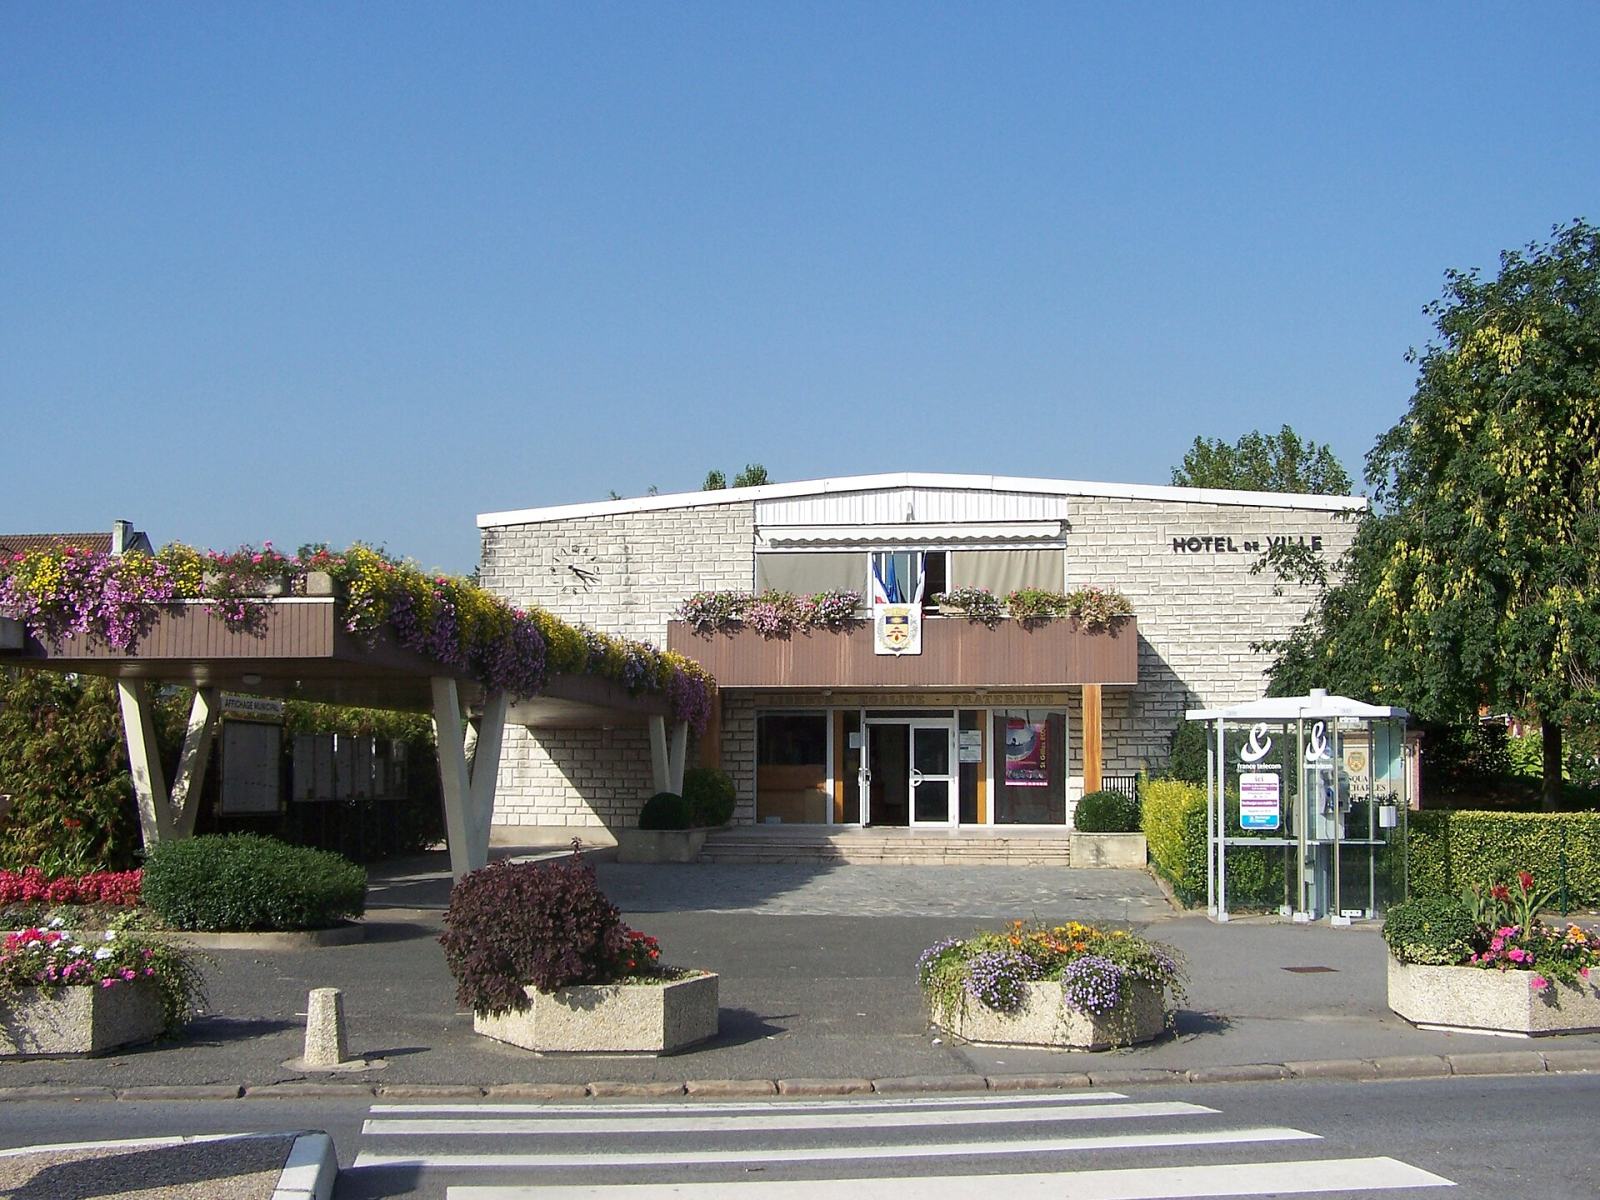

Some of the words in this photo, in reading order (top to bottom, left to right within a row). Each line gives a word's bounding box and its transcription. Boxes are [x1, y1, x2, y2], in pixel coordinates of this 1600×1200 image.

[1172, 536, 1239, 552] HOTEL
[1243, 541, 1260, 551] DE
[1266, 535, 1323, 551] VILLE
